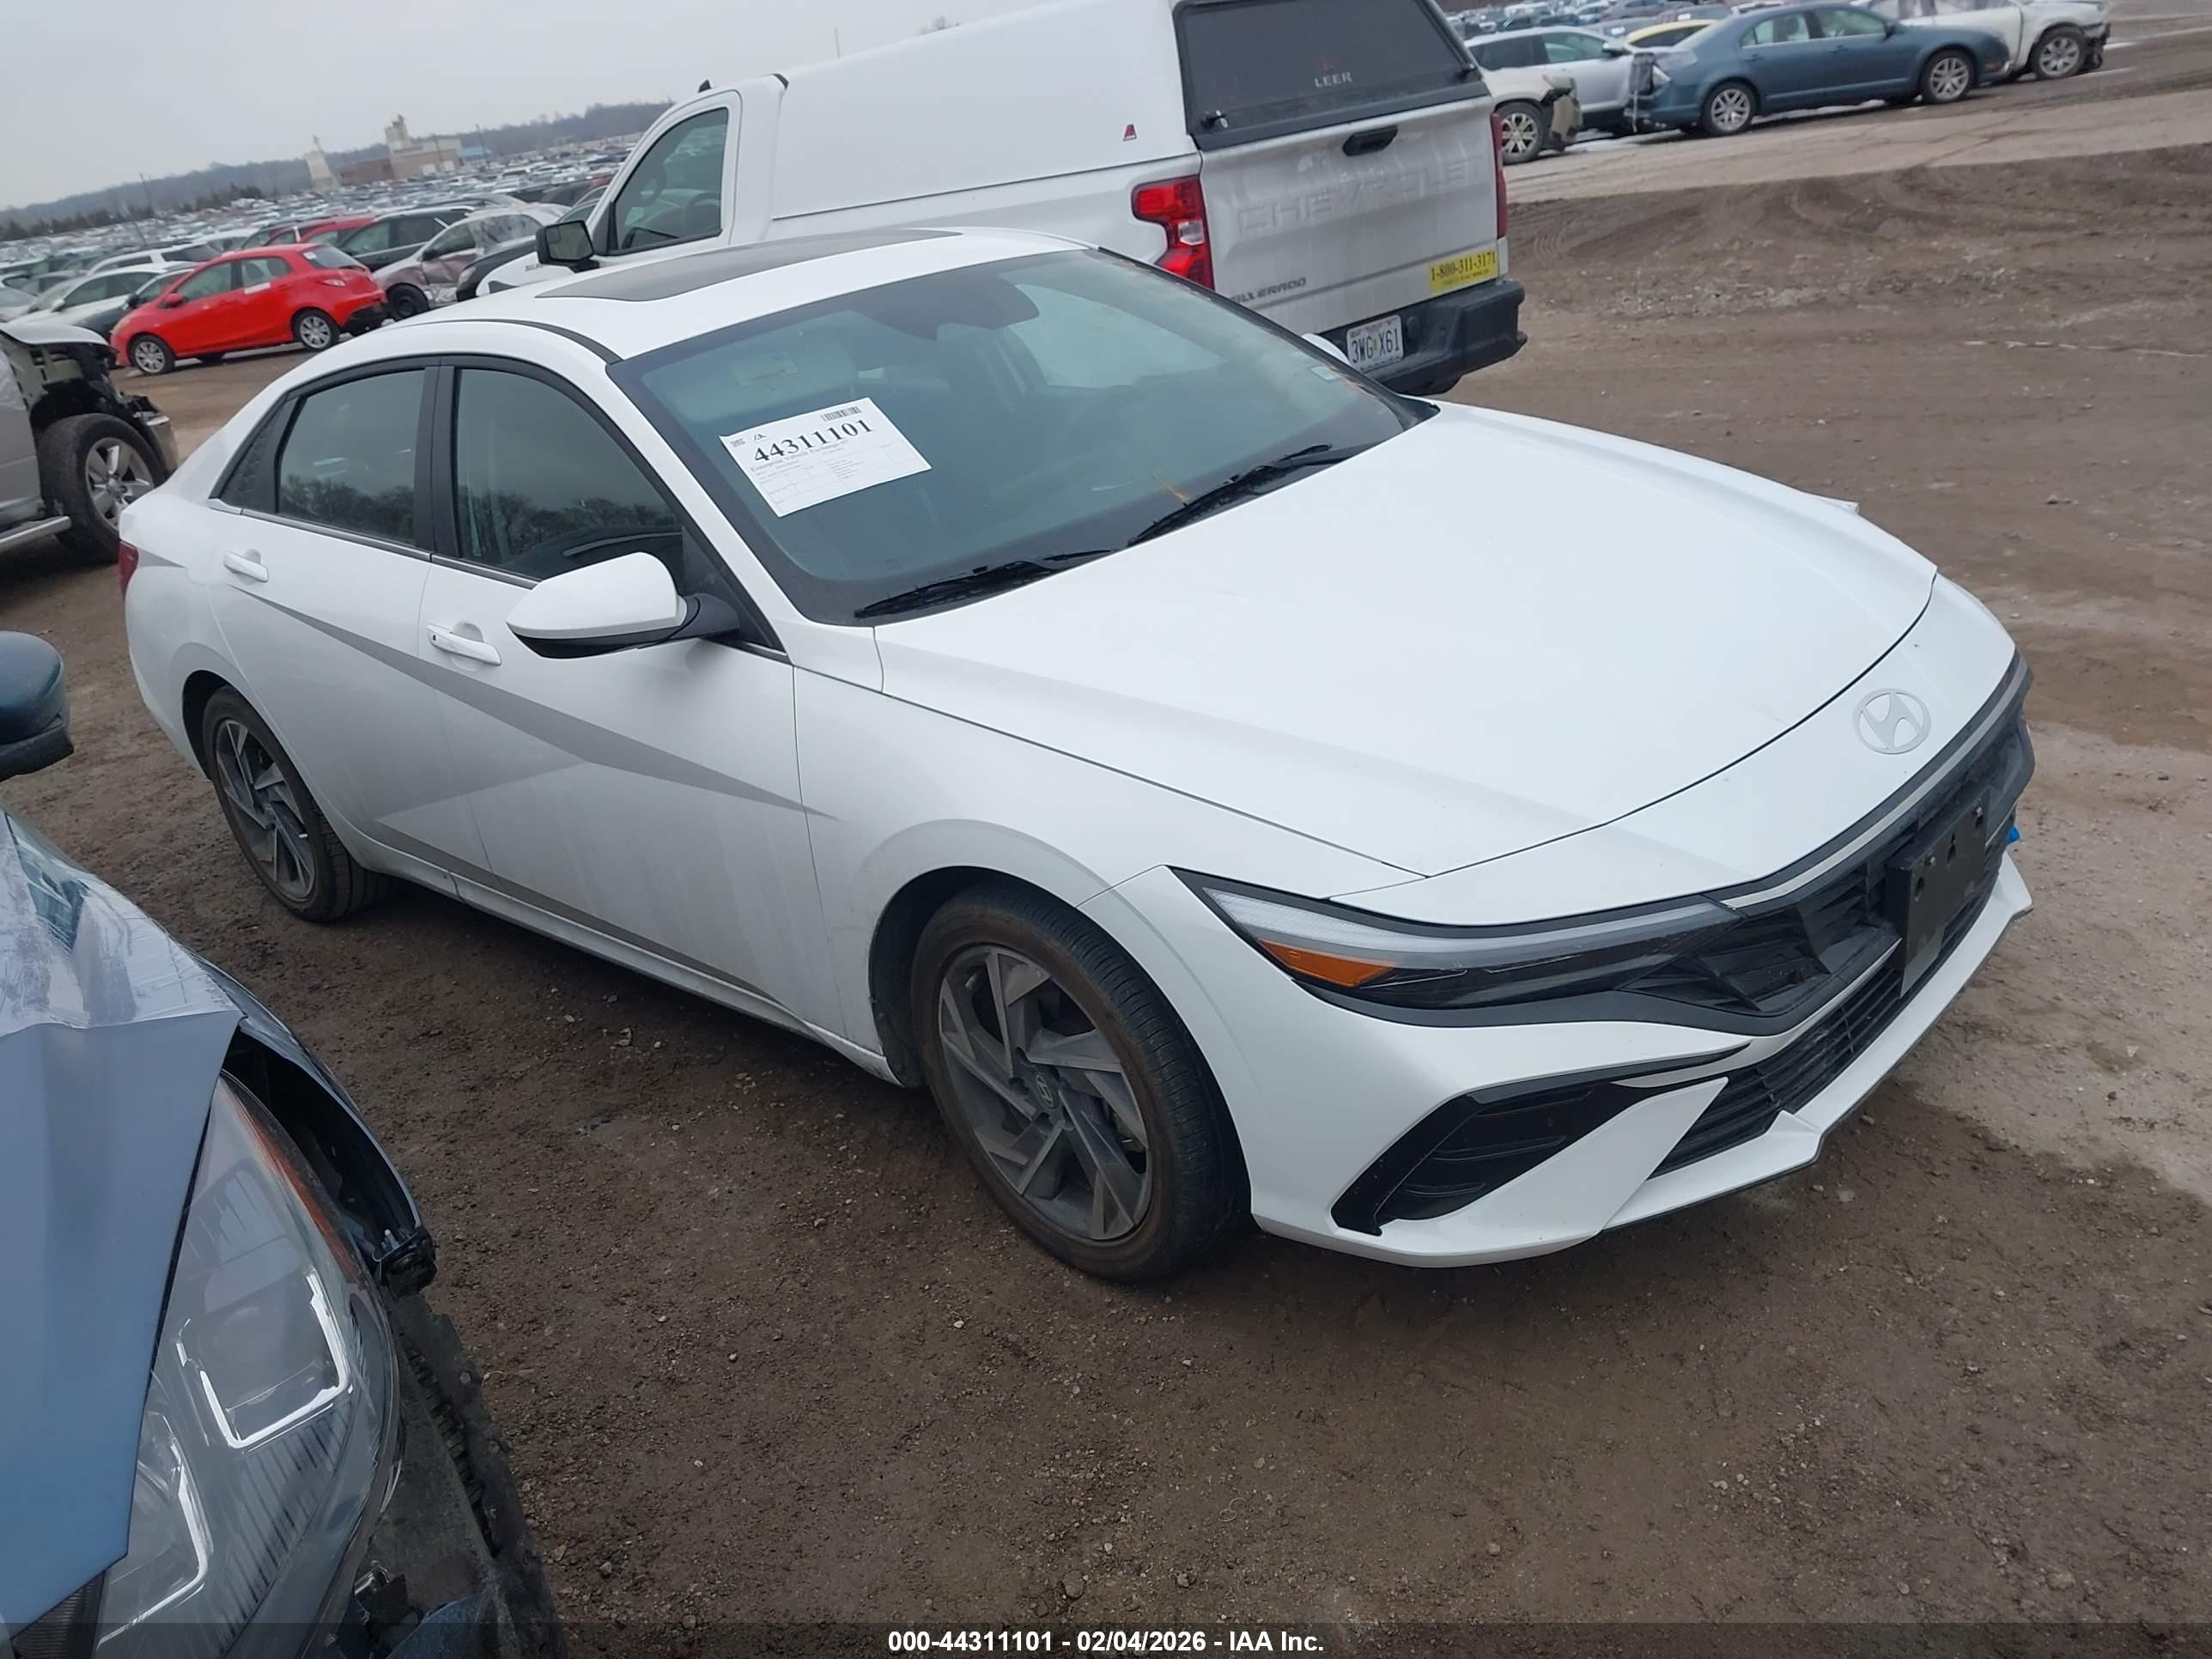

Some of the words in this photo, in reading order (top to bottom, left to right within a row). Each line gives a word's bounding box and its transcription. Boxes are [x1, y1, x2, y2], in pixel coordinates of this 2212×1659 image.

[1314, 71, 1352, 88] LEER
[1238, 157, 1488, 234] CHEVROLET
[754, 419, 874, 462] 44311101
